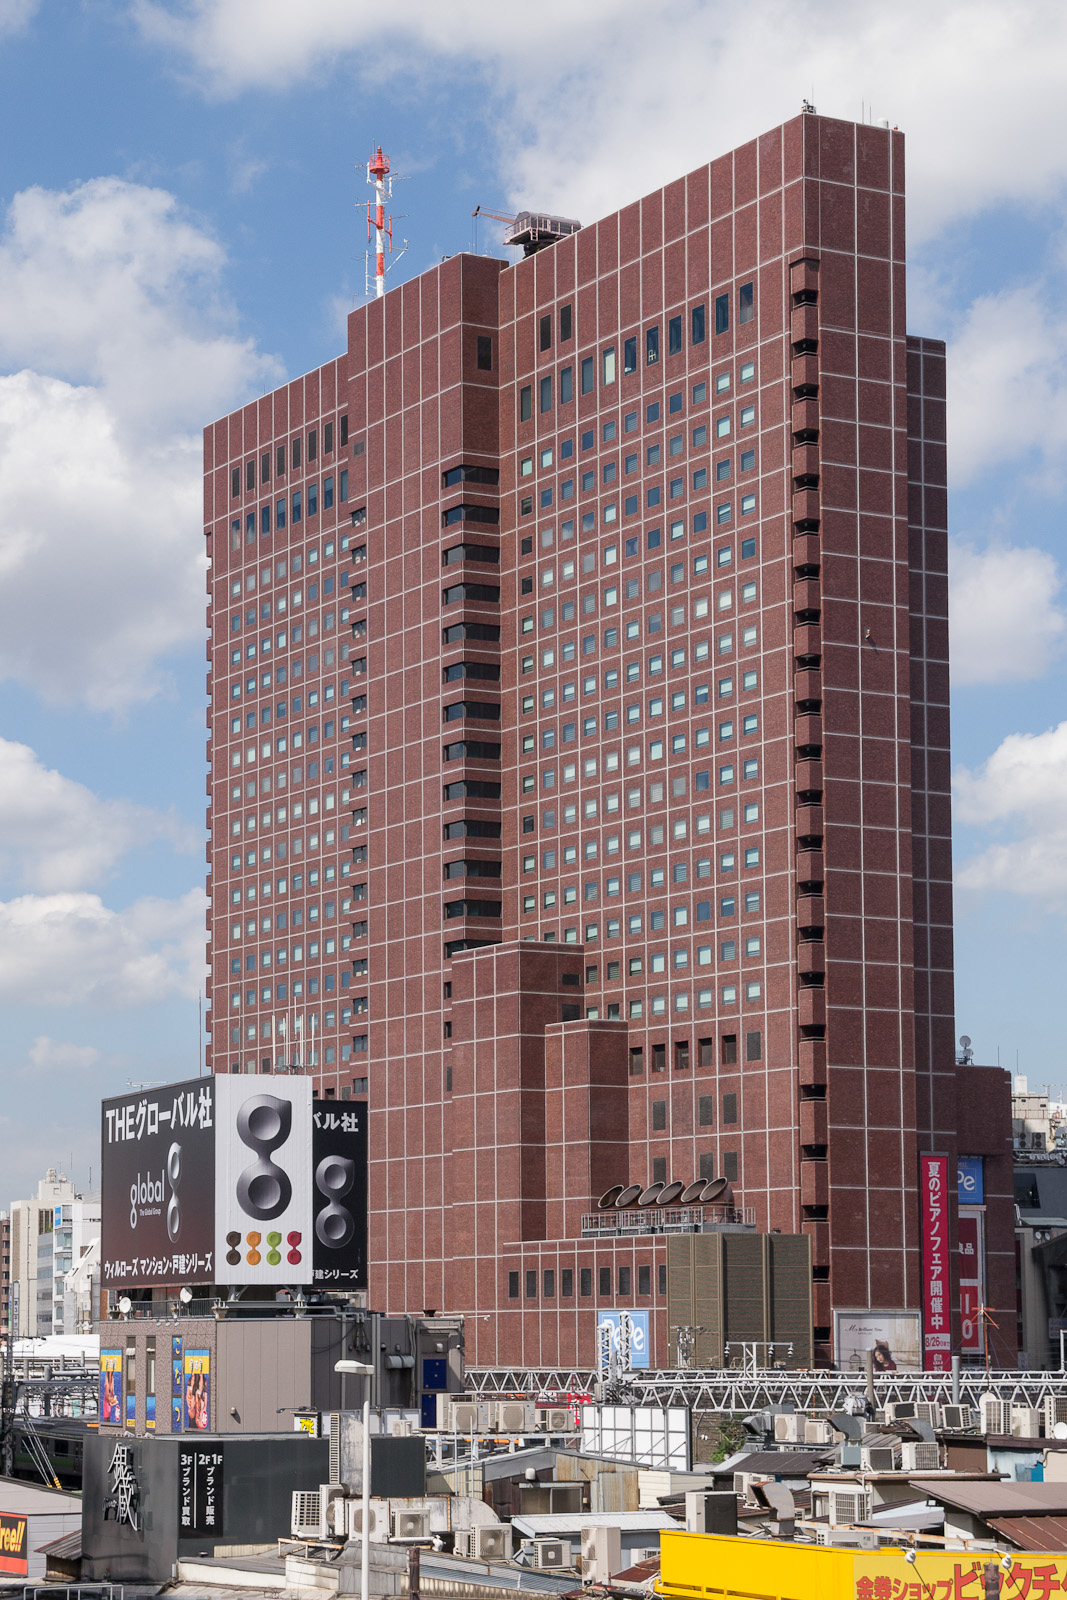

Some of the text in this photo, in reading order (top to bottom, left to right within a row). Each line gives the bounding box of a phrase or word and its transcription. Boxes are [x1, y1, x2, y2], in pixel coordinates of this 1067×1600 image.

[105, 1086, 213, 1143] THEグローバル社
[130, 1169, 165, 1229] global
[104, 1257, 139, 1279] ウィルローズ
[928, 1162, 943, 1330] 夏のピアノフェア開催中
[312, 1269, 359, 1280] 建シリーズ
[181, 1454, 193, 1465] 3F
[198, 1453, 223, 1465] 2F 1F
[181, 1467, 191, 1526] ブランド買取
[205, 1466, 215, 1526] ブランド販売
[0, 1518, 26, 1553] ree!!
